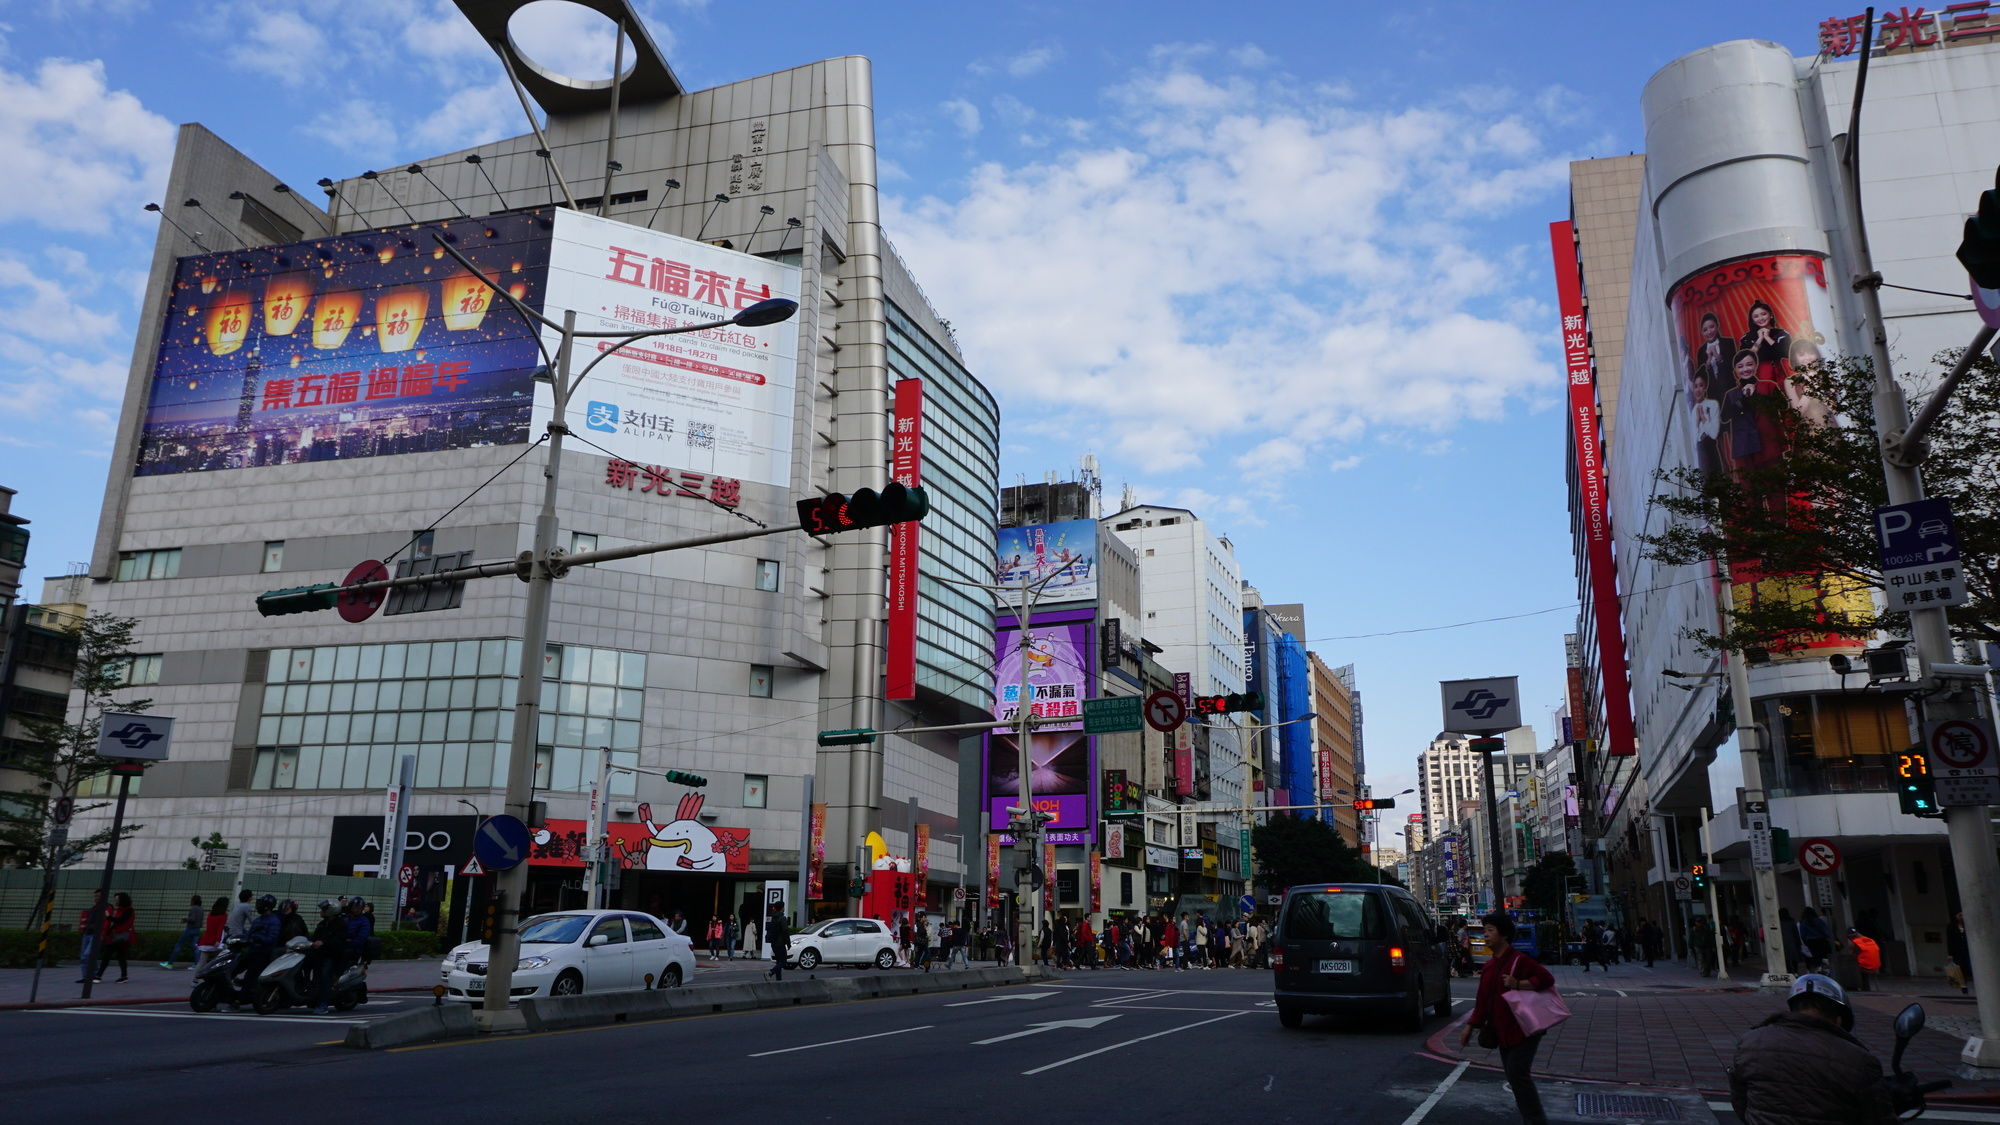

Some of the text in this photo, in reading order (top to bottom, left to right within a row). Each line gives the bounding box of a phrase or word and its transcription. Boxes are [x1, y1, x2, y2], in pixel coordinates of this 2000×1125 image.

[605, 245, 771, 311] 五福來台
[271, 294, 294, 320] 福
[460, 284, 487, 314] 福
[219, 310, 242, 333] 福
[322, 307, 345, 332] 福
[387, 311, 410, 336] 福
[614, 304, 677, 330] 掃福集福
[600, 319, 619, 330] Scan
[678, 337, 698, 346] cards
[709, 342, 729, 352] claim
[743, 350, 769, 362] packets
[1564, 314, 1590, 386] 新光三越
[262, 361, 471, 411] 集五福 過福年
[623, 408, 675, 433] 支付宝
[624, 428, 673, 442] ALIPAY
[896, 417, 914, 488] 新光三越
[605, 458, 742, 507] 新光三越
[1579, 406, 1603, 541] SHIN KONG MITSUKOSHI
[1879, 510, 1912, 549] P
[899, 531, 907, 558] KONG
[1885, 553, 1924, 566] 100公尺
[897, 558, 906, 611] MITSUKOSHI
[1902, 587, 1951, 605] 停車場
[1003, 701, 1077, 721] 才真殺菌
[1899, 754, 1926, 777] 27
[361, 831, 451, 850] ADO
[1693, 865, 1704, 875] 27
[561, 879, 582, 890] ALD
